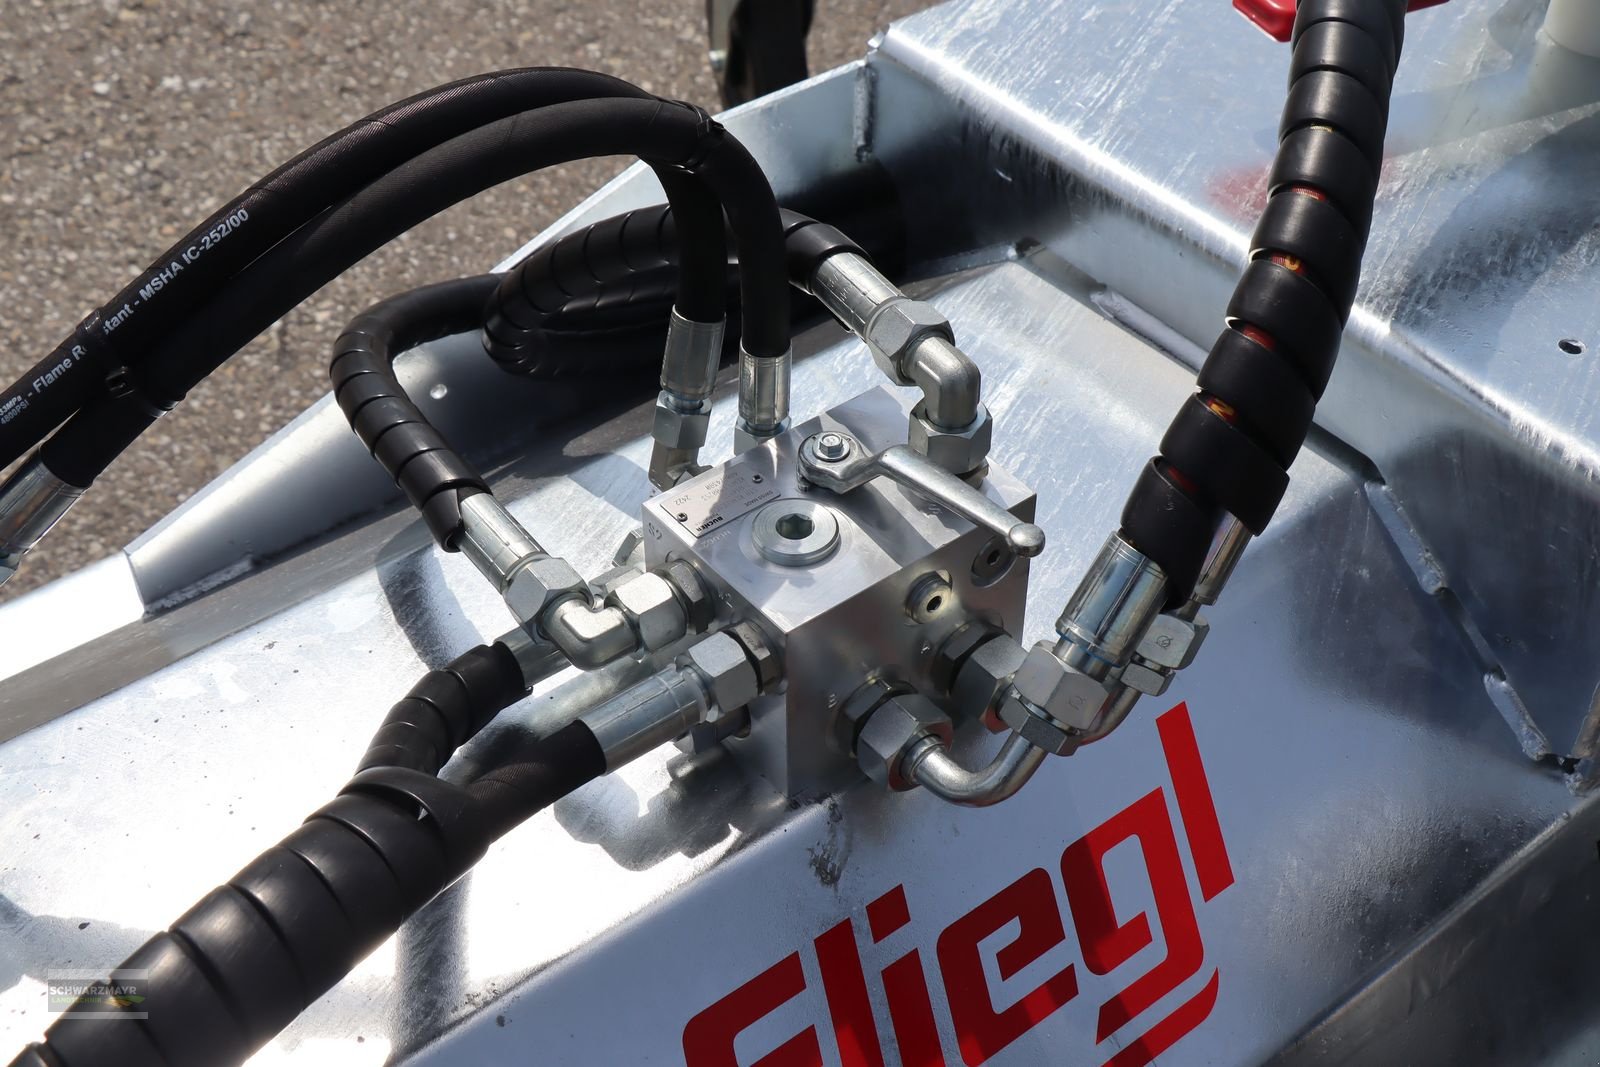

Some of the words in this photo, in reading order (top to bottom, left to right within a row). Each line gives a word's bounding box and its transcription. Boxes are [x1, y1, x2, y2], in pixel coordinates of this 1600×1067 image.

[32, 358, 73, 393] Flame
[70, 345, 88, 361] R
[139, 261, 184, 301] MSHA
[182, 208, 249, 265] IC-252/00
[696, 516, 723, 532] BUCHER
